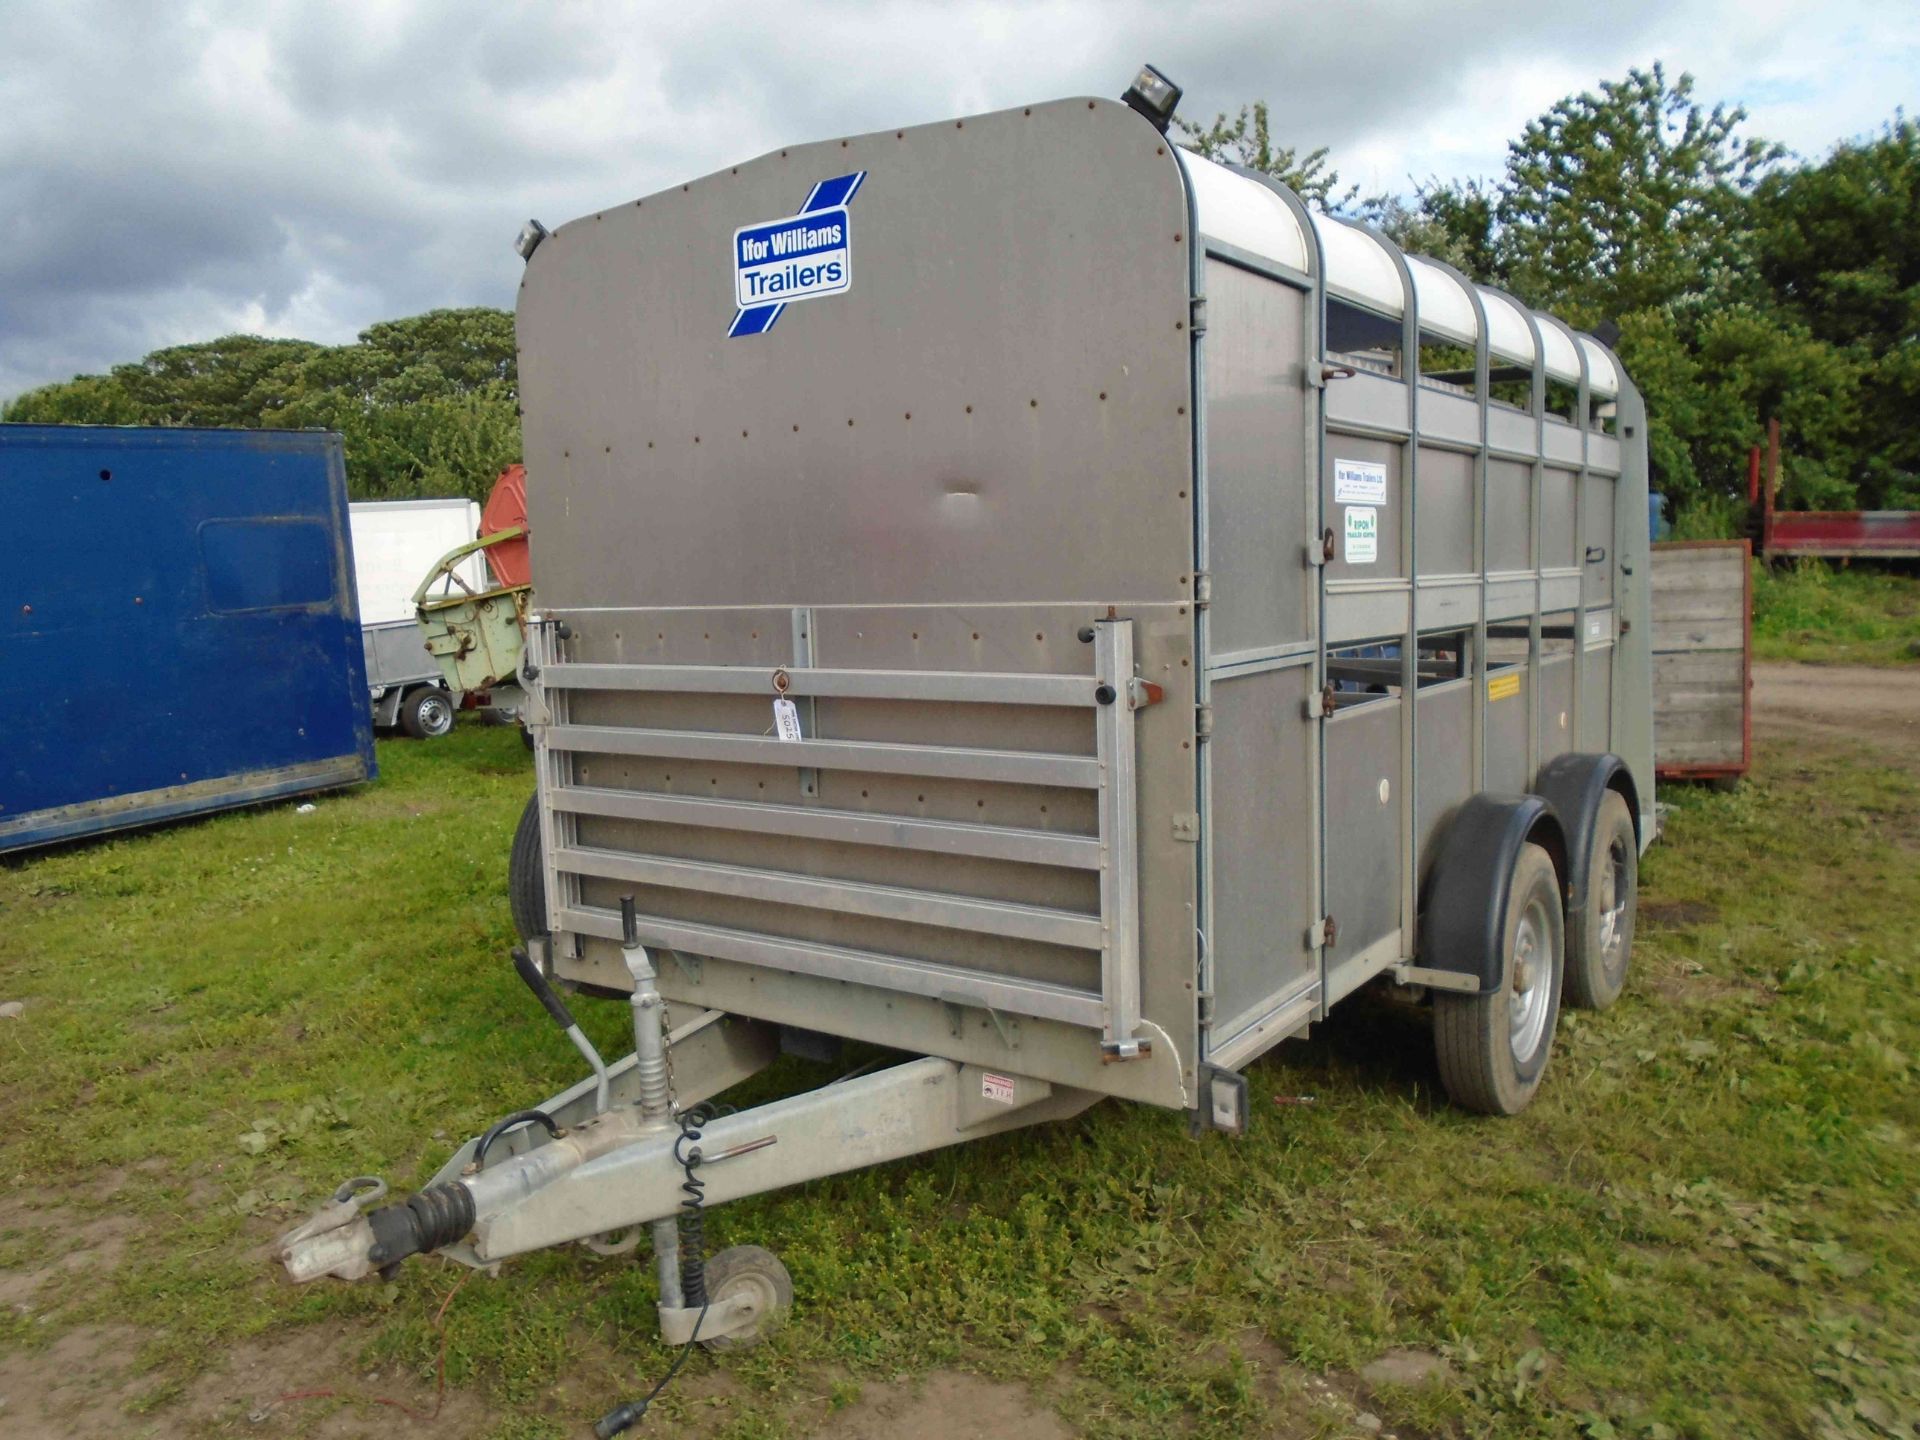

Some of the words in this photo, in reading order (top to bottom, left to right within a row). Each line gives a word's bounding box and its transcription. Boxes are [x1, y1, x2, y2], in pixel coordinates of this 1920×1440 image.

[742, 238, 769, 262] Ifor
[770, 224, 842, 256] Williams
[744, 261, 842, 296] Trailers
